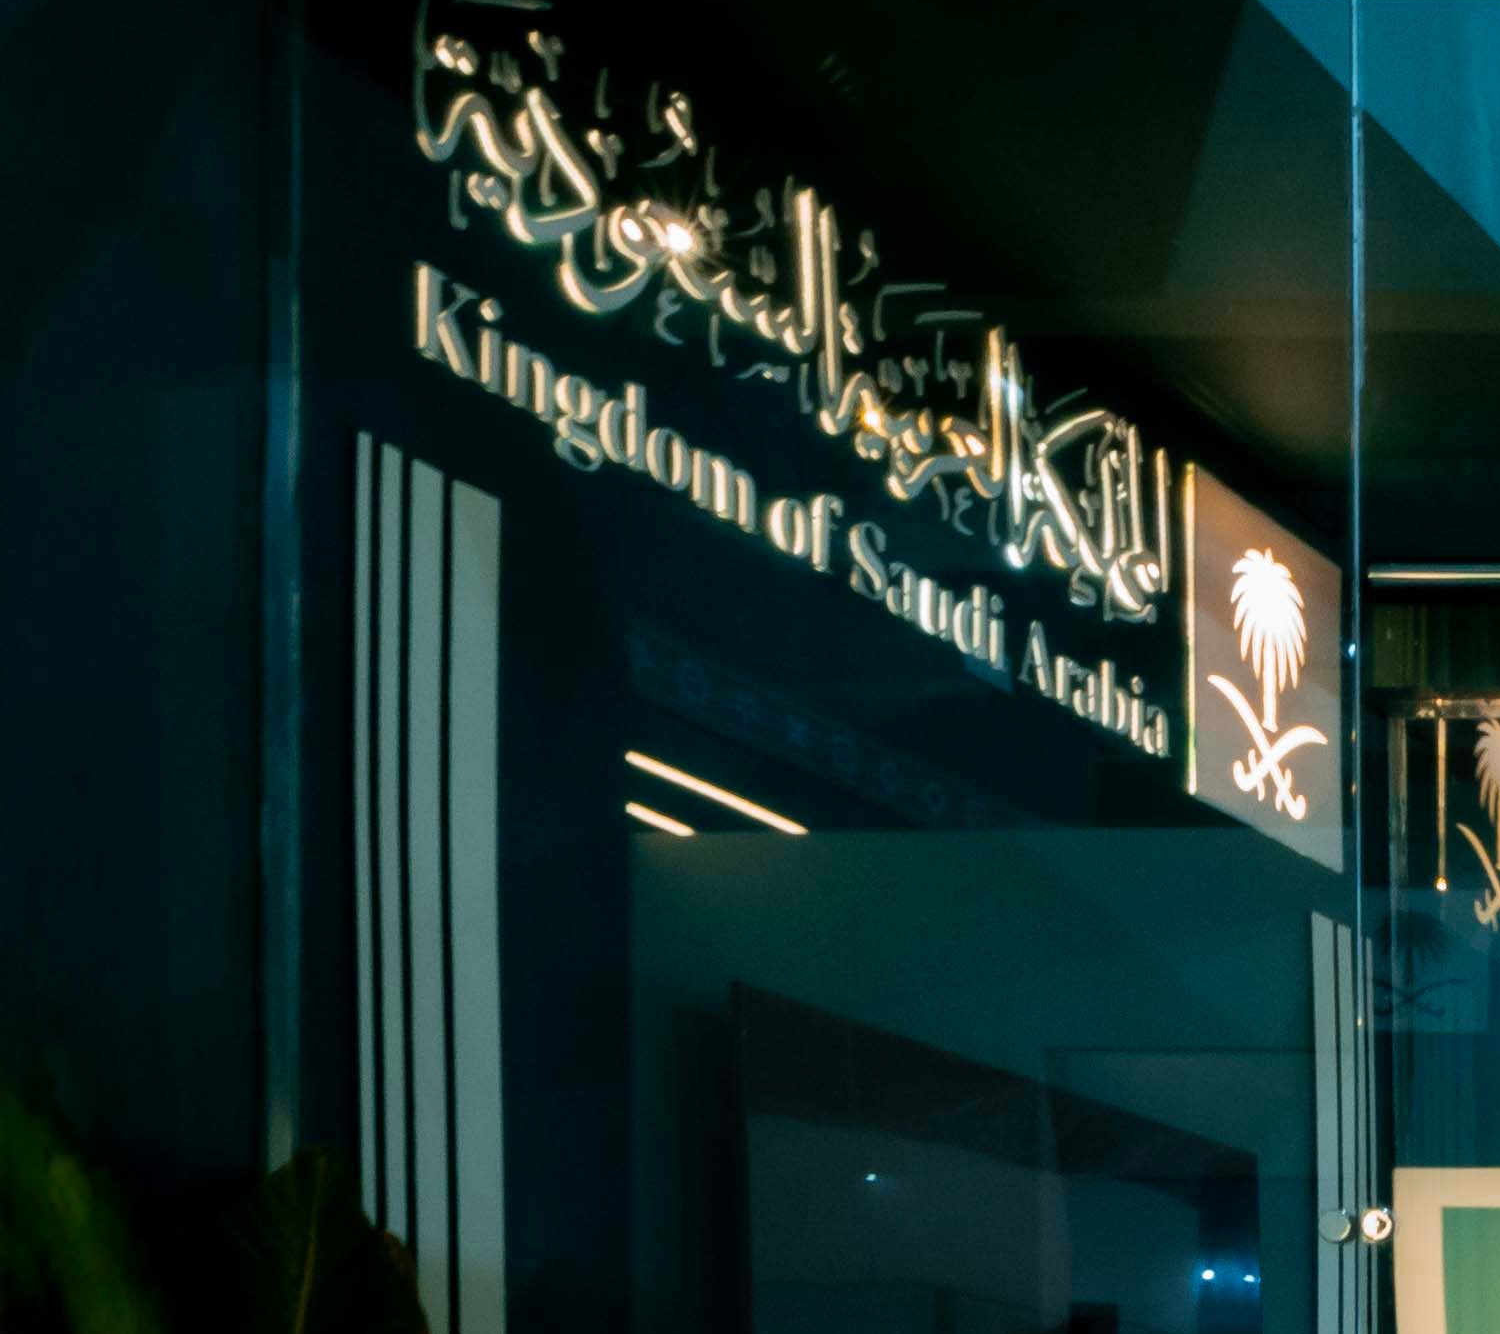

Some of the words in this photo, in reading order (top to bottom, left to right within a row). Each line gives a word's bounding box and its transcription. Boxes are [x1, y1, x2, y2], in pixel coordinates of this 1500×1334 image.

[413, 261, 758, 524] Kingdom
[767, 493, 845, 573] of
[848, 521, 1005, 670] Saudi
[1018, 619, 1170, 758] Arabia
